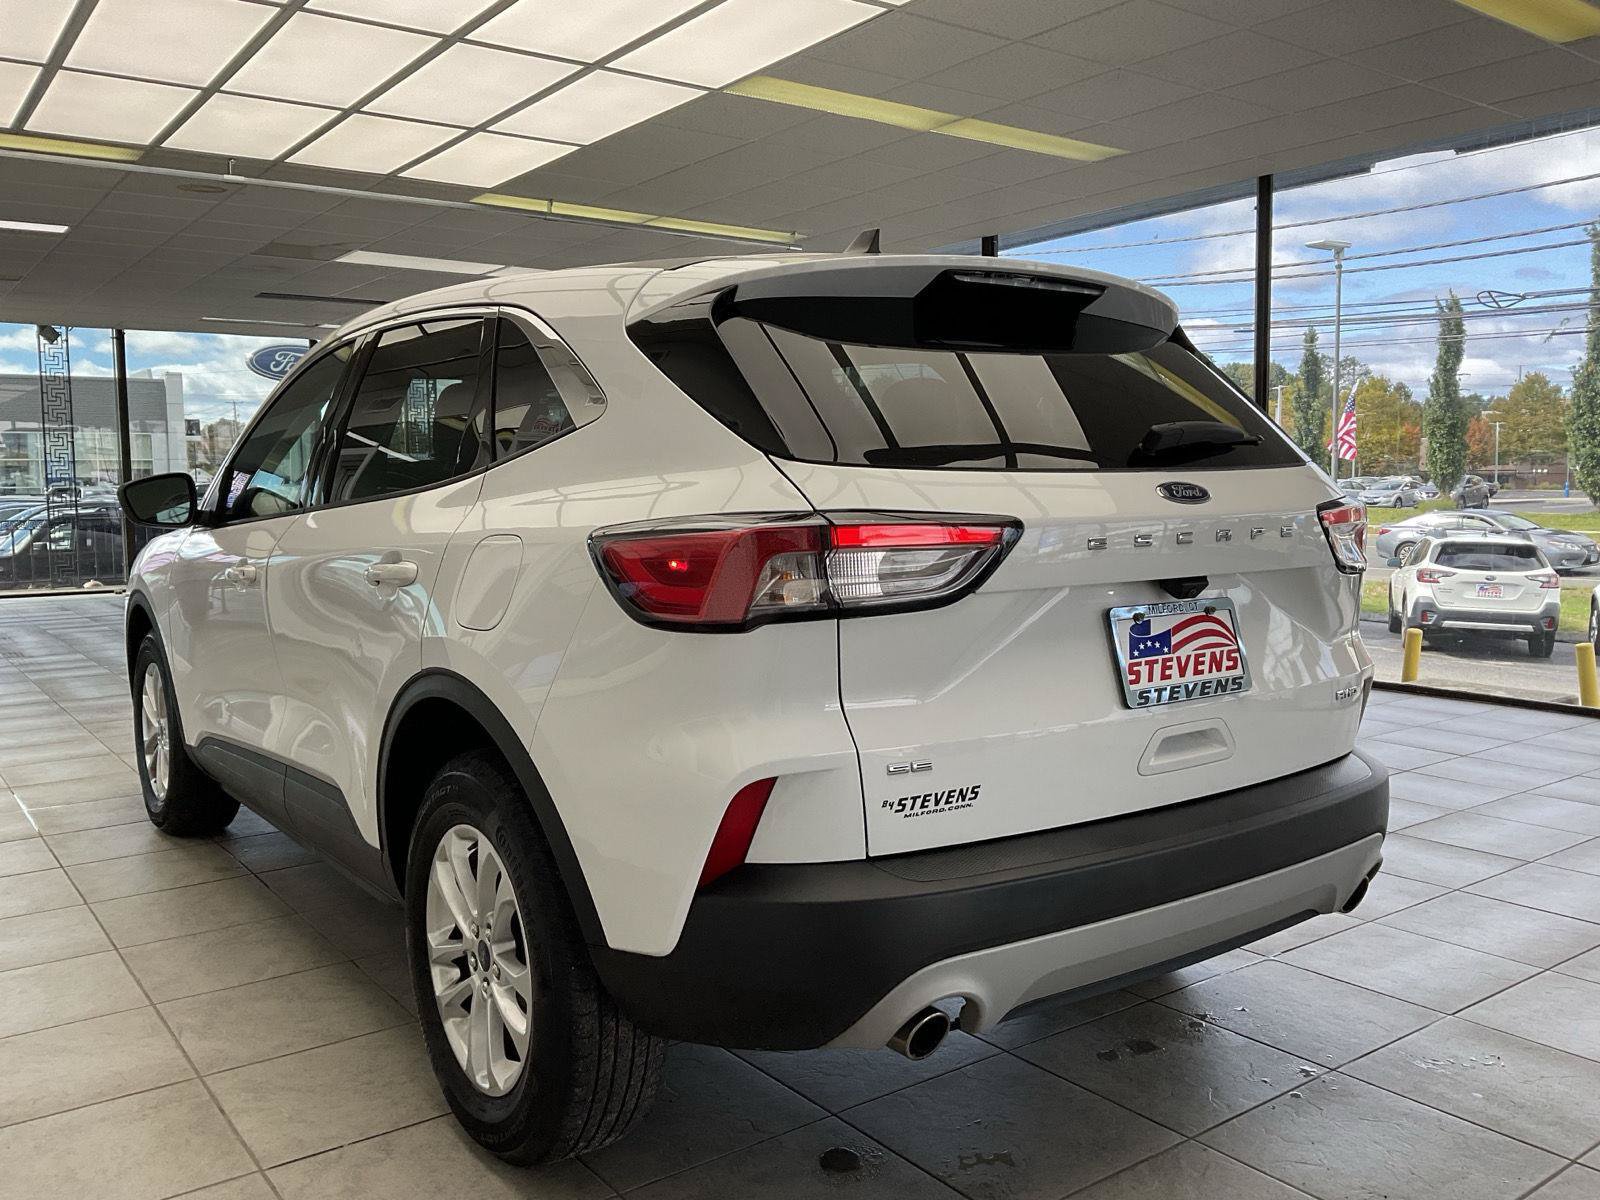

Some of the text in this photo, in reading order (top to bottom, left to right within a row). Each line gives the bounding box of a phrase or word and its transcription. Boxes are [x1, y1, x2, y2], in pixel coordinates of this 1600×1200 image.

[1171, 484, 1203, 497] Ford
[1088, 525, 1294, 550] ESCAPE
[1128, 648, 1240, 686] STEVENS
[1136, 676, 1245, 706] STEVENS
[886, 760, 933, 775] SE
[894, 784, 982, 814] STEVENS
